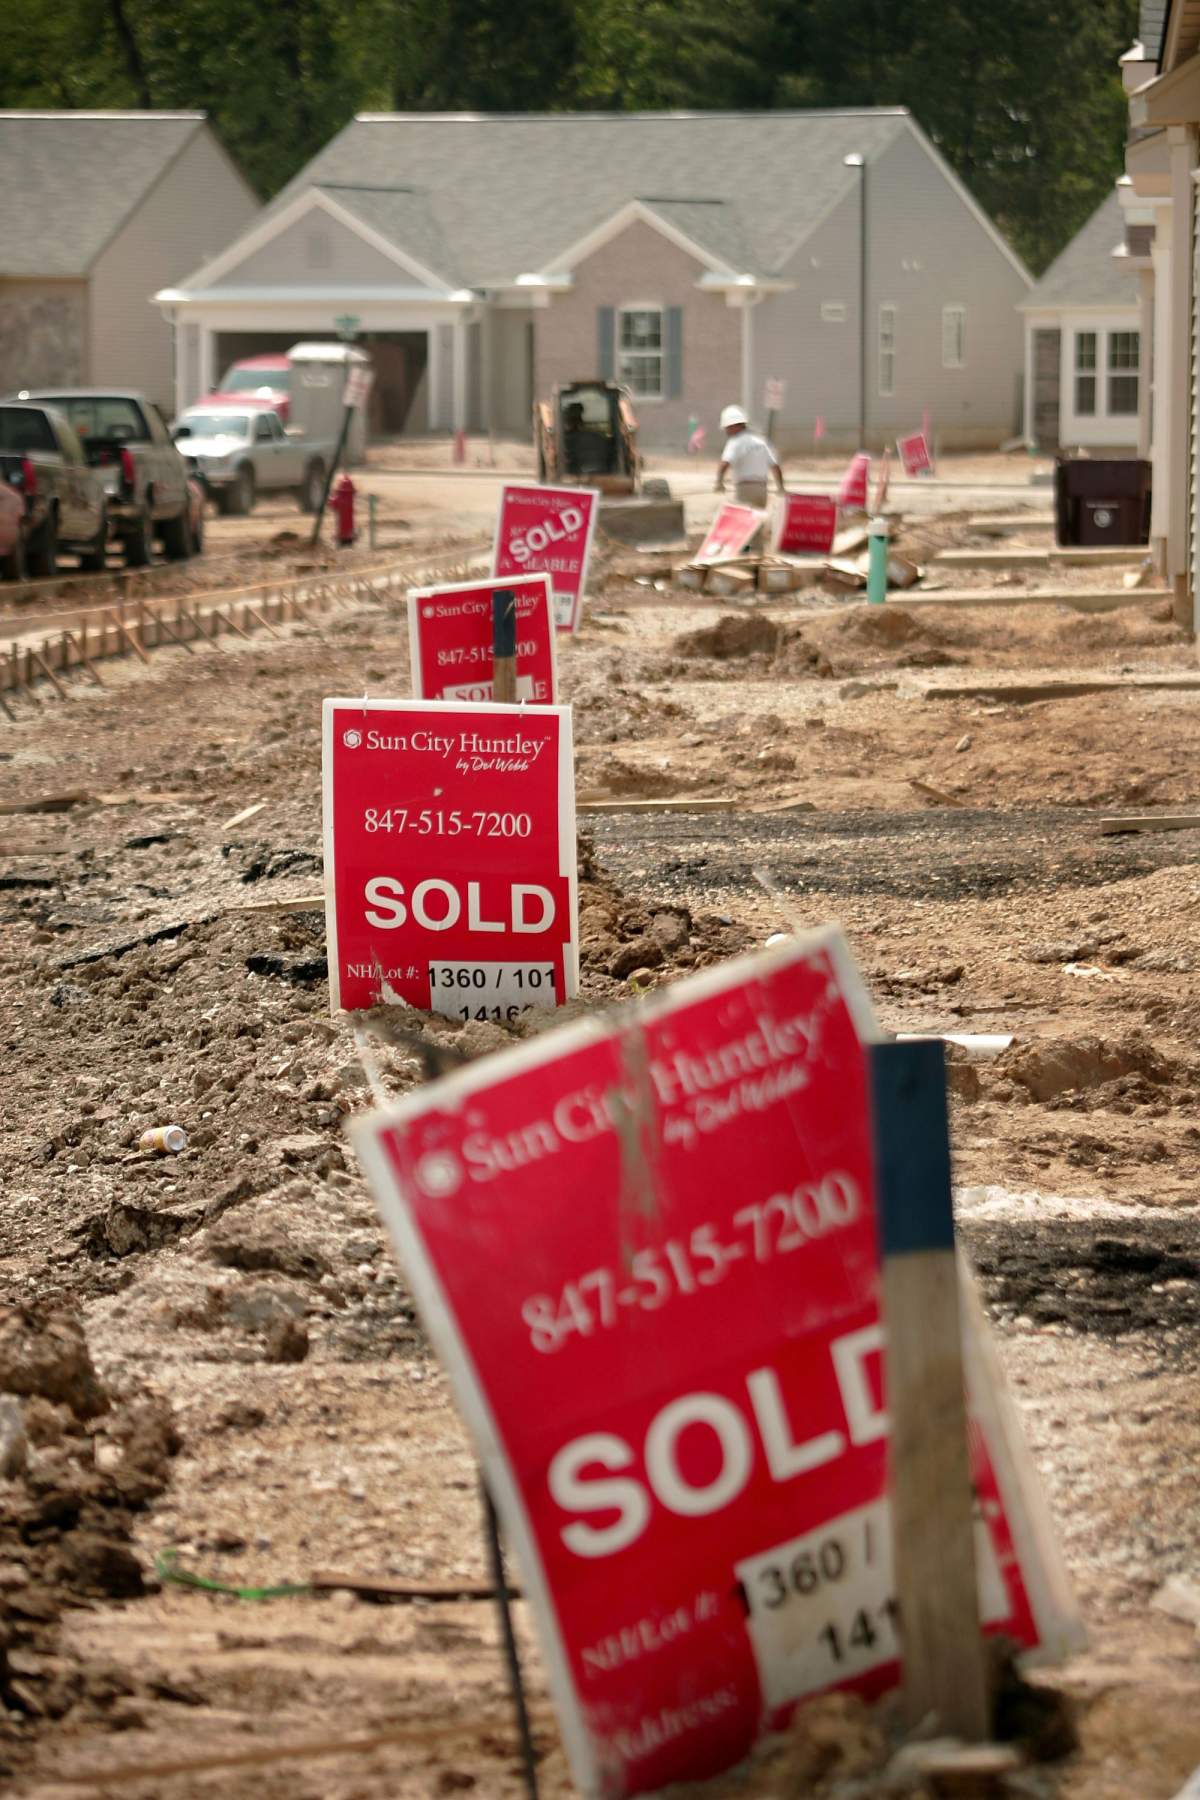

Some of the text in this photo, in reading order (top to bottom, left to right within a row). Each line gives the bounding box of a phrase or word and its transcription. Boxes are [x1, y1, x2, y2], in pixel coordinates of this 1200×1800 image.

[508, 507, 583, 564] SOLD
[435, 604, 460, 618] Sun
[462, 601, 488, 616] City
[366, 730, 544, 760] Sun City Huntley
[456, 756, 528, 775] by Del Webb
[364, 808, 531, 838] 847-515-7200
[364, 876, 556, 934] SOLD
[428, 968, 486, 988] 1360
[496, 969, 502, 988] /
[513, 968, 555, 988] 101
[459, 1005, 534, 1022] 1416
[461, 1118, 559, 1182] Sun
[648, 1011, 820, 1104] Huntley
[664, 1113, 696, 1149] by
[521, 1169, 861, 1354] 847-515-7200
[731, 1539, 844, 1619] 1360
[818, 1597, 901, 1664] 141
